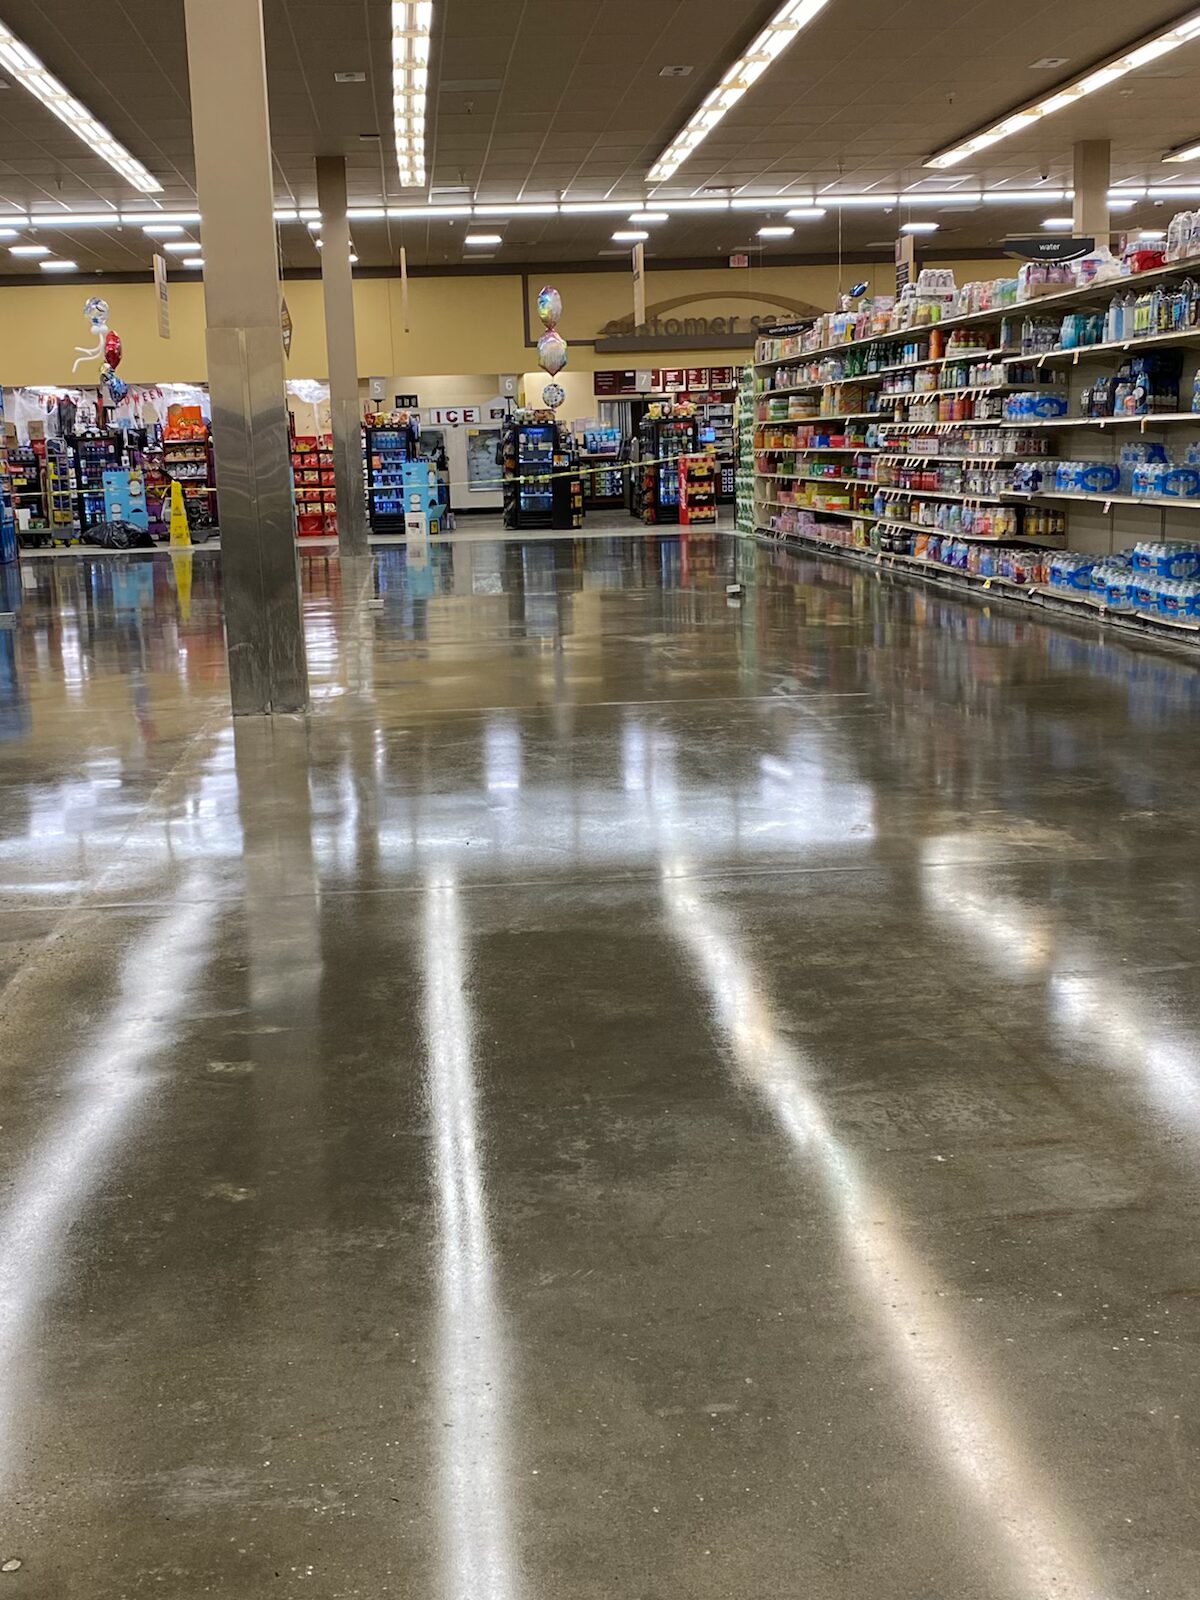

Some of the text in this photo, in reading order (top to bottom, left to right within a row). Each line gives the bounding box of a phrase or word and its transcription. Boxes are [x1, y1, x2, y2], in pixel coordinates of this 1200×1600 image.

[505, 379, 513, 391] 6
[640, 375, 647, 386] 7
[373, 382, 381, 393] 5
[435, 409, 475, 424] ICE
[553, 460, 570, 468] KIND
